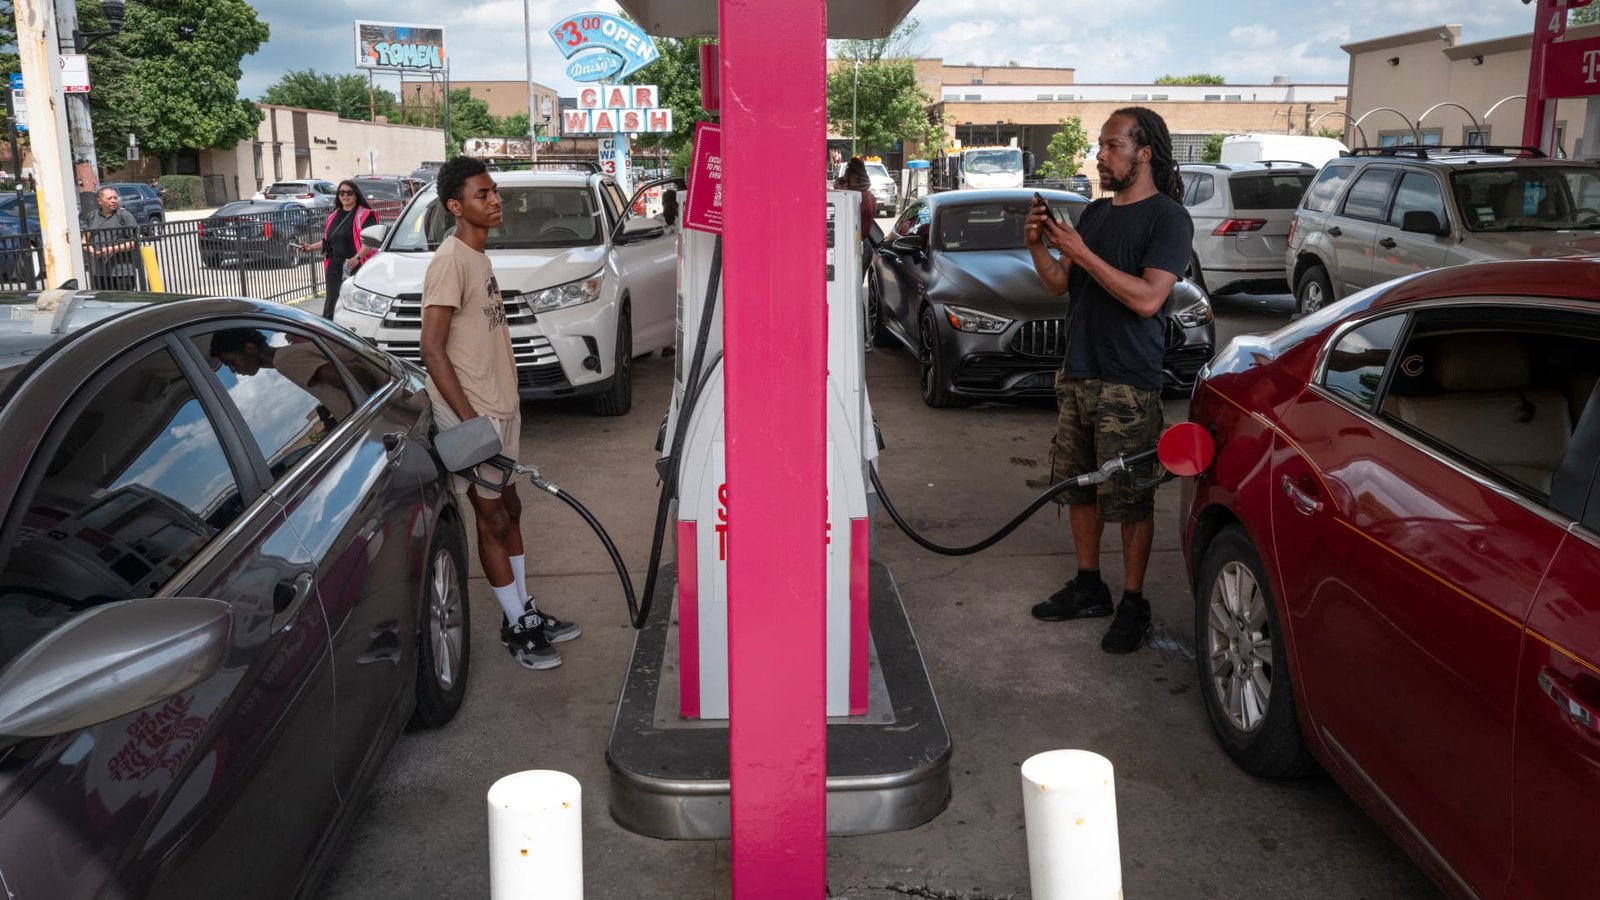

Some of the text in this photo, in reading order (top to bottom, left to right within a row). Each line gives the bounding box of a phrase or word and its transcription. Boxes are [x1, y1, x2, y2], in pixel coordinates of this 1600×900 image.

[1548, 11, 1561, 33] 4
[602, 19, 654, 61] OPEN
[374, 41, 444, 69] ROMEN
[571, 57, 618, 77] Daisy's
[580, 87, 653, 108] CAR
[565, 111, 668, 132] WASH
